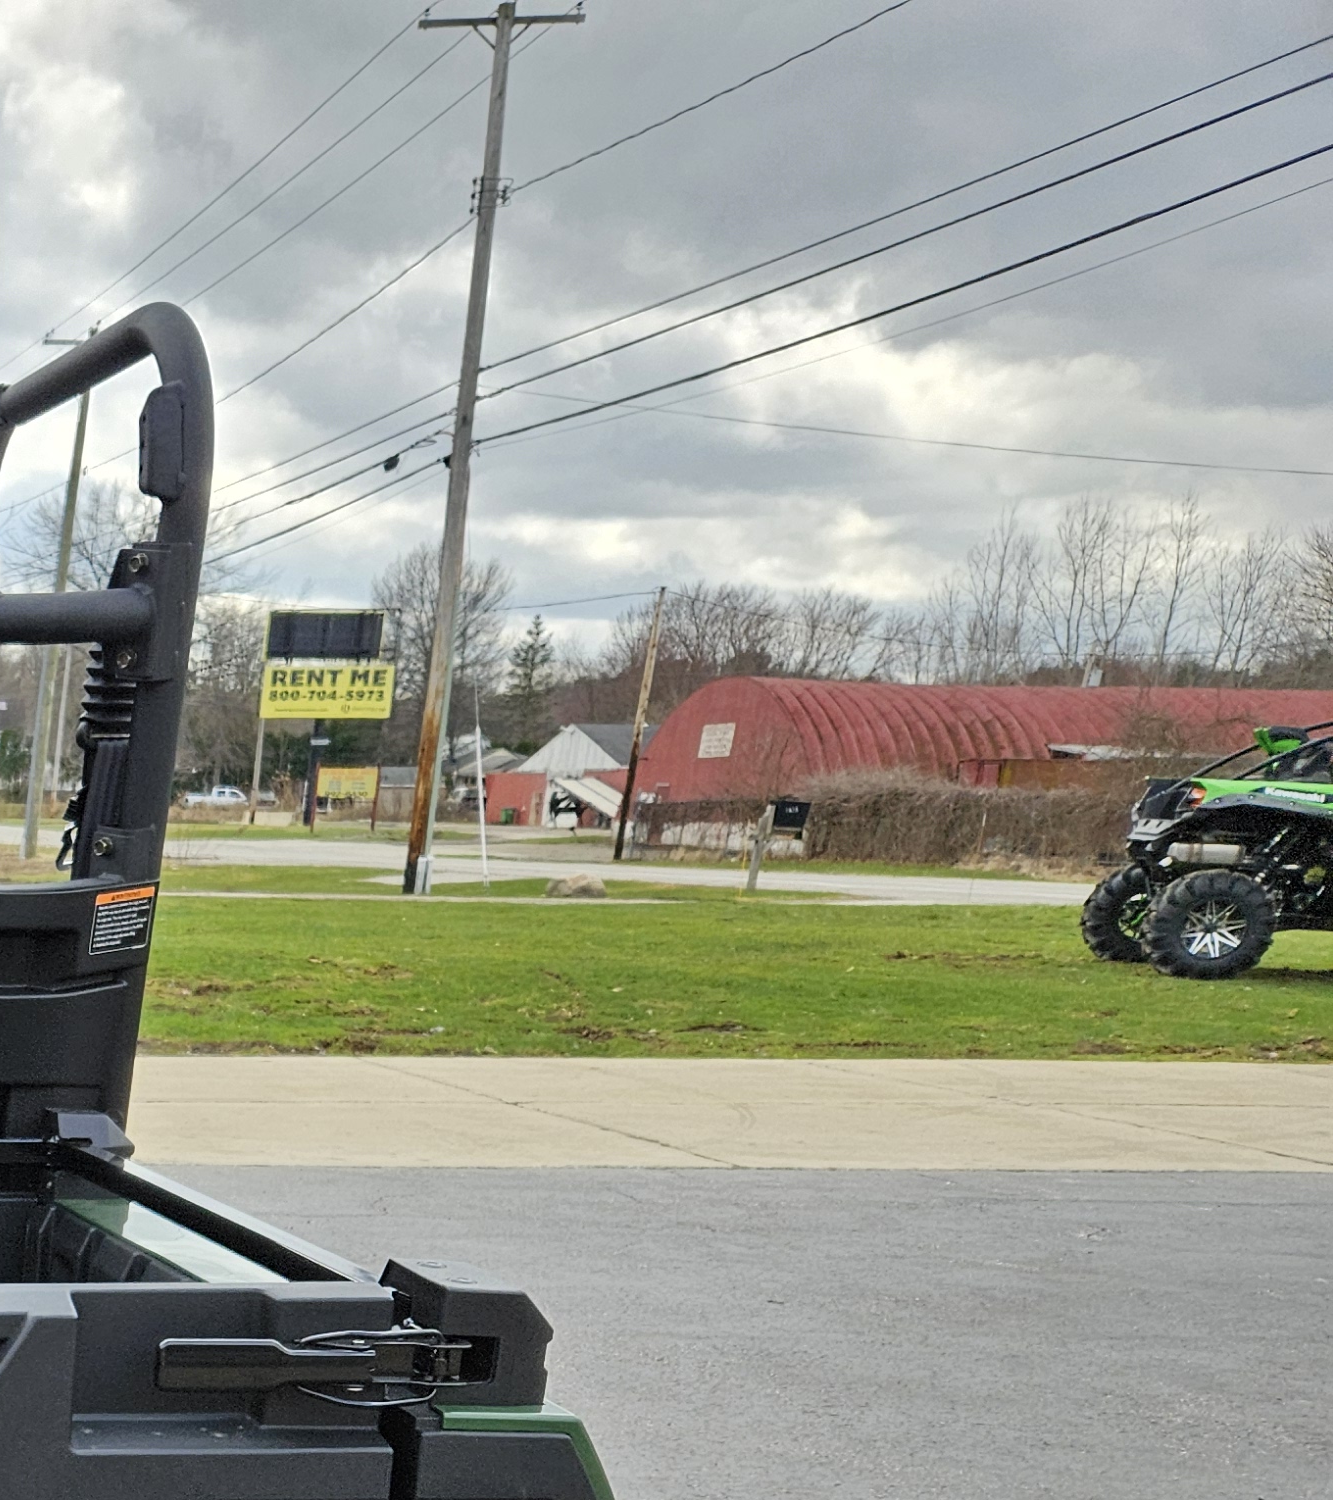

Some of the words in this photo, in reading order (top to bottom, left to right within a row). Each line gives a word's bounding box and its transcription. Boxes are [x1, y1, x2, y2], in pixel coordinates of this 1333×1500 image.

[271, 669, 343, 687] RENT
[350, 669, 388, 687] ME
[268, 690, 385, 702] 800-704-5973
